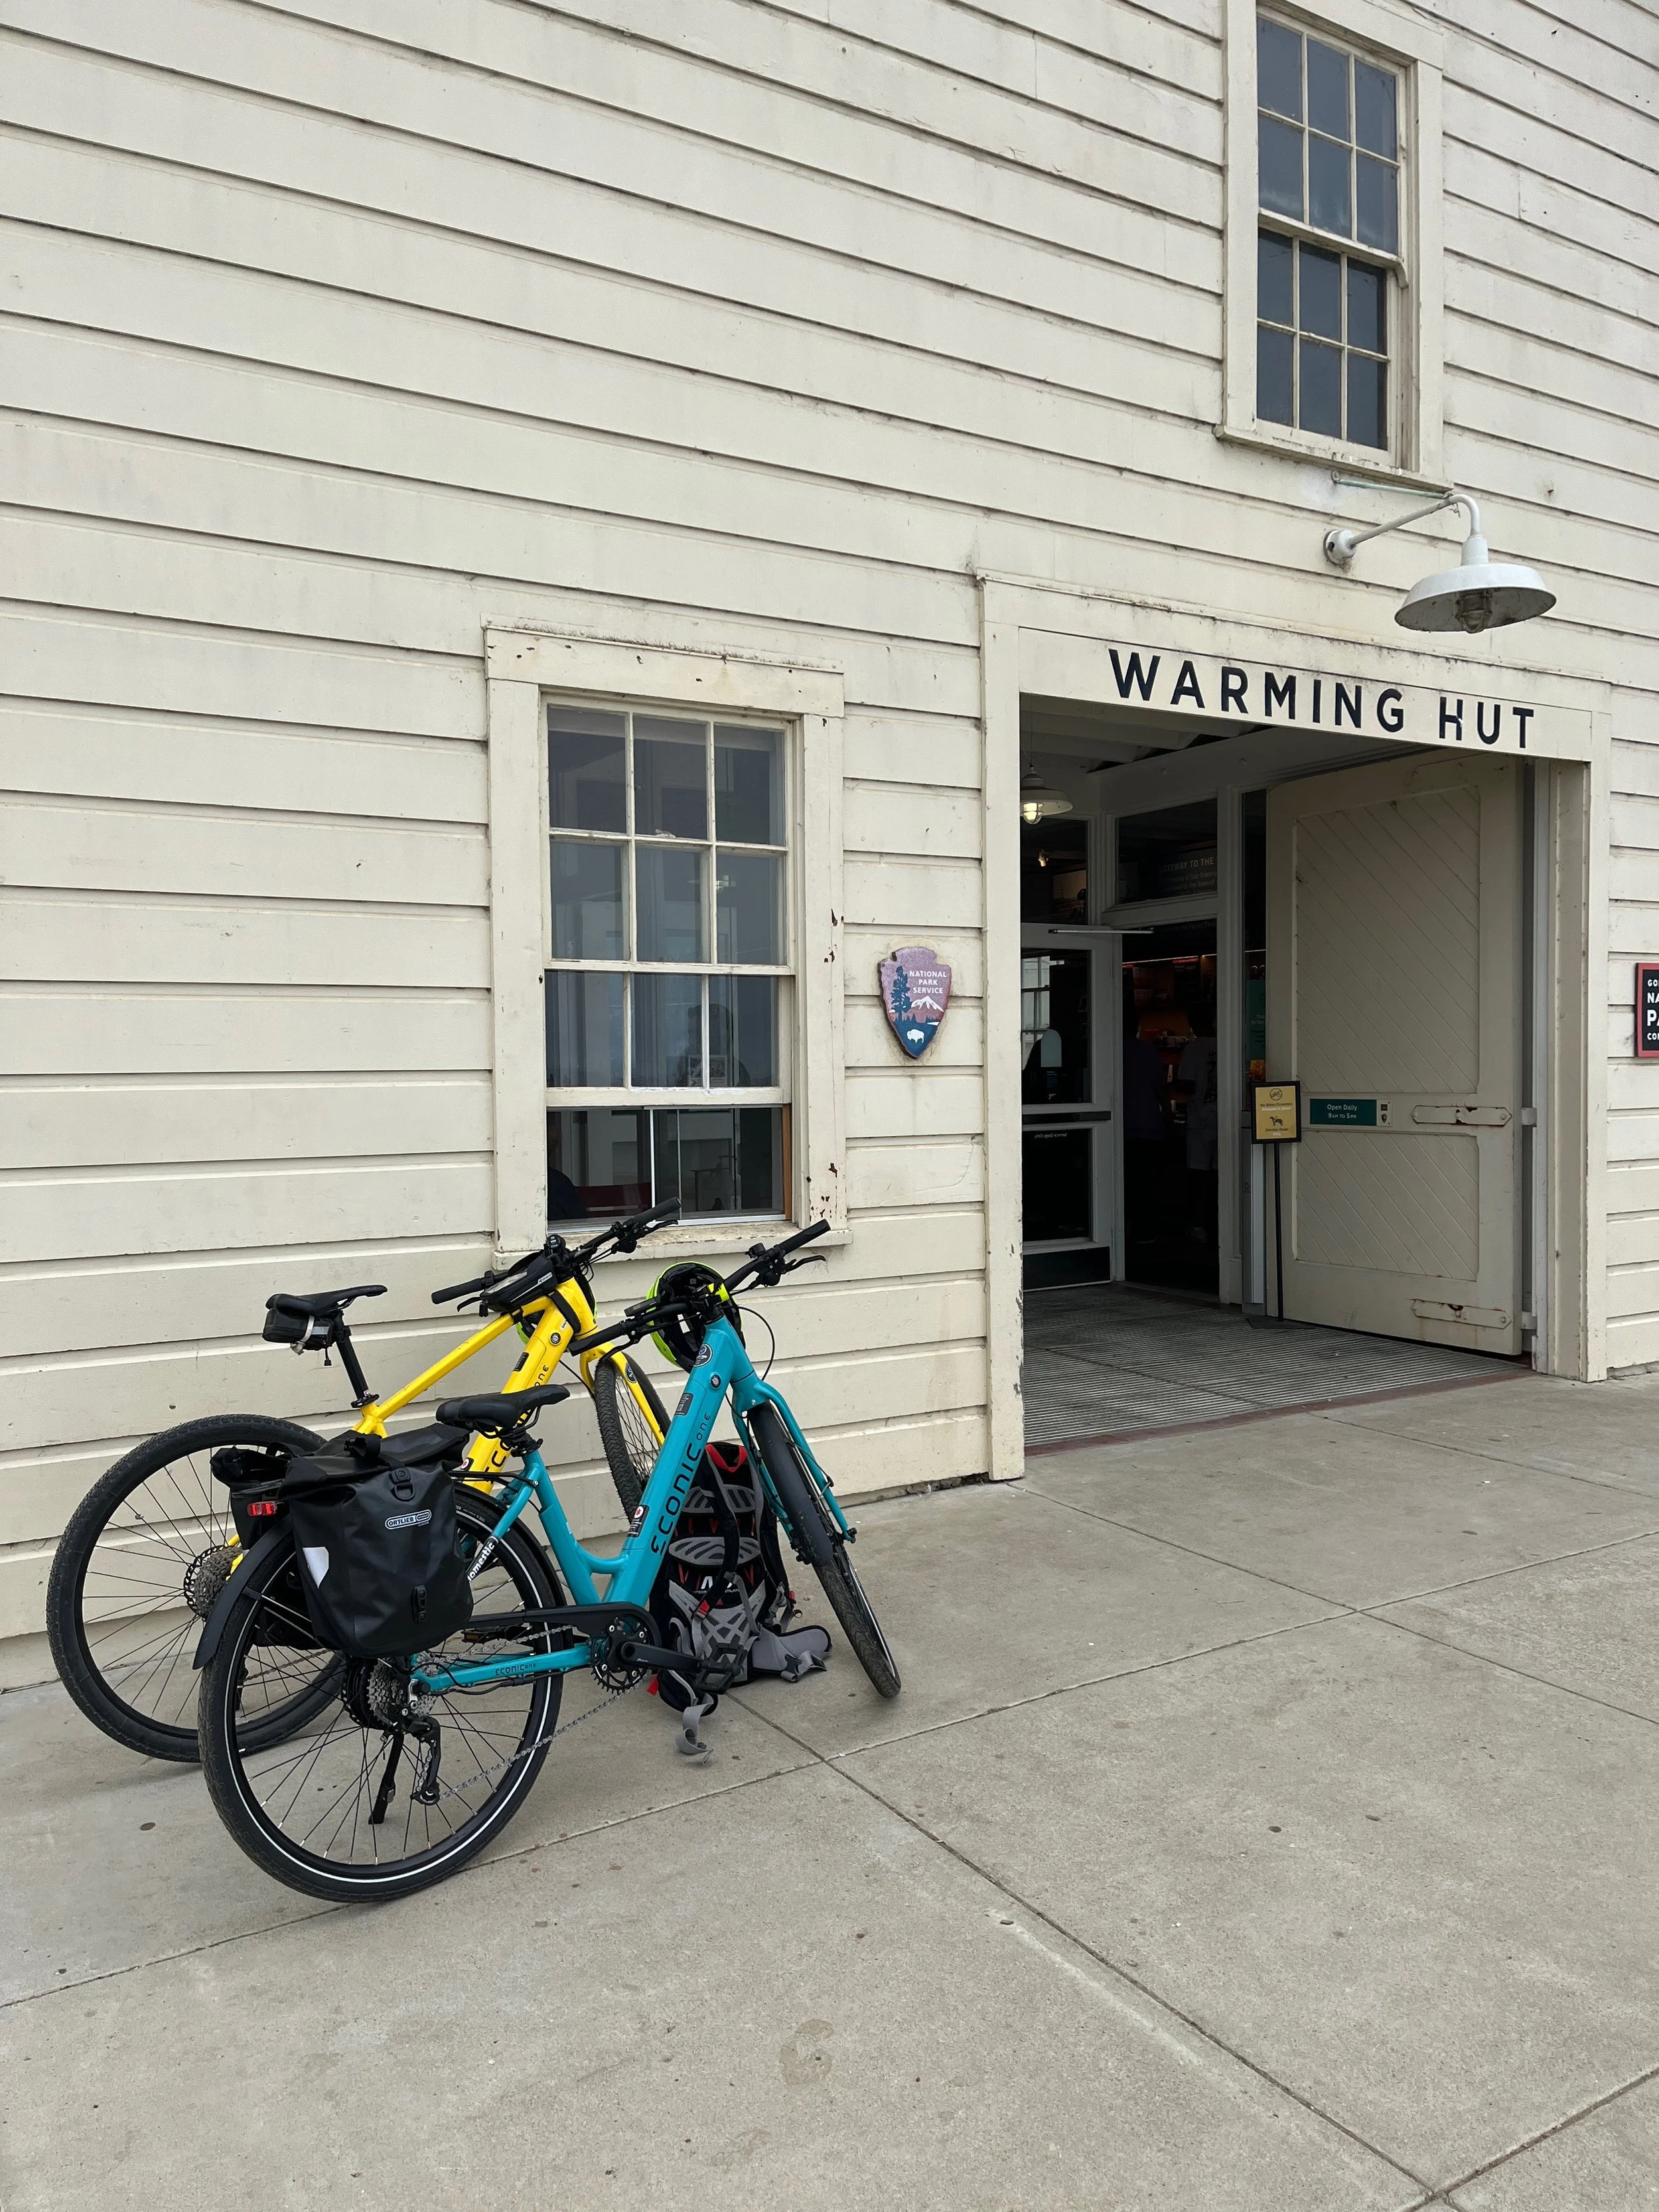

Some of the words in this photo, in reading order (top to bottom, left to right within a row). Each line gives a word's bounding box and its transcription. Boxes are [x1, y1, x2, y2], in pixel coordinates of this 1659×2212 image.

[1108, 648, 1404, 733] WARMING
[1439, 696, 1534, 749] HUT
[1200, 857, 1214, 866] THE
[651, 1443, 701, 1556] ECONIC
[389, 1517, 414, 1526] ORTLIEB
[496, 1664, 524, 1676] ECONIC
